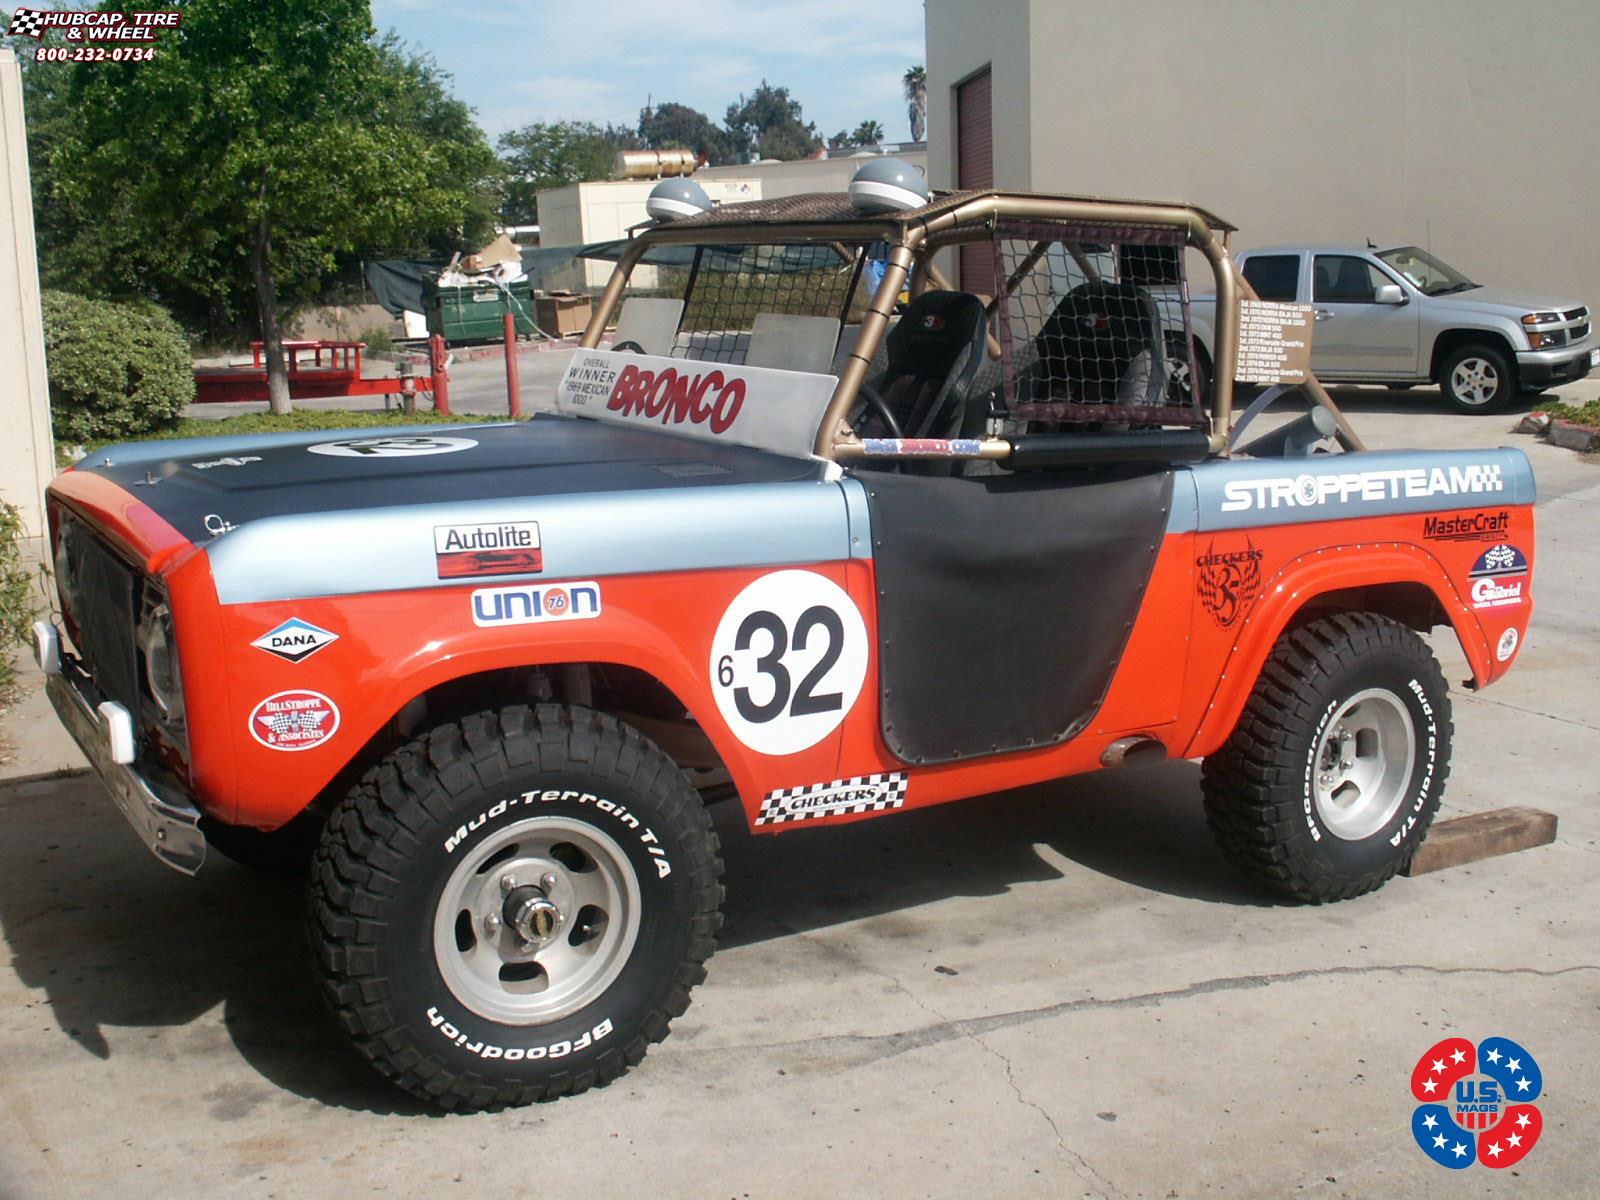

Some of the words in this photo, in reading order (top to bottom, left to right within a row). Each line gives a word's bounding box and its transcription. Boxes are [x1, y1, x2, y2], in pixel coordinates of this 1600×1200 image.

[569, 366, 616, 383] WINNER
[583, 357, 609, 369] OVERALL
[606, 364, 747, 434] BRONCO
[1424, 512, 1509, 535] MasterCraft
[445, 526, 532, 550] Autolite
[1197, 550, 1263, 567] CHECKERS
[549, 596, 565, 610] 76
[272, 634, 317, 647] DANA
[718, 655, 734, 687] 6
[733, 605, 844, 724] 32
[267, 733, 276, 743] &
[1408, 679, 1437, 812] Mud-Terrain
[791, 788, 877, 810] CHECKERS
[444, 789, 641, 854] Mud-Terrain
[639, 828, 672, 879] T/A
[1389, 815, 1416, 847] T/A
[426, 1006, 614, 1060] BFGoodrich
